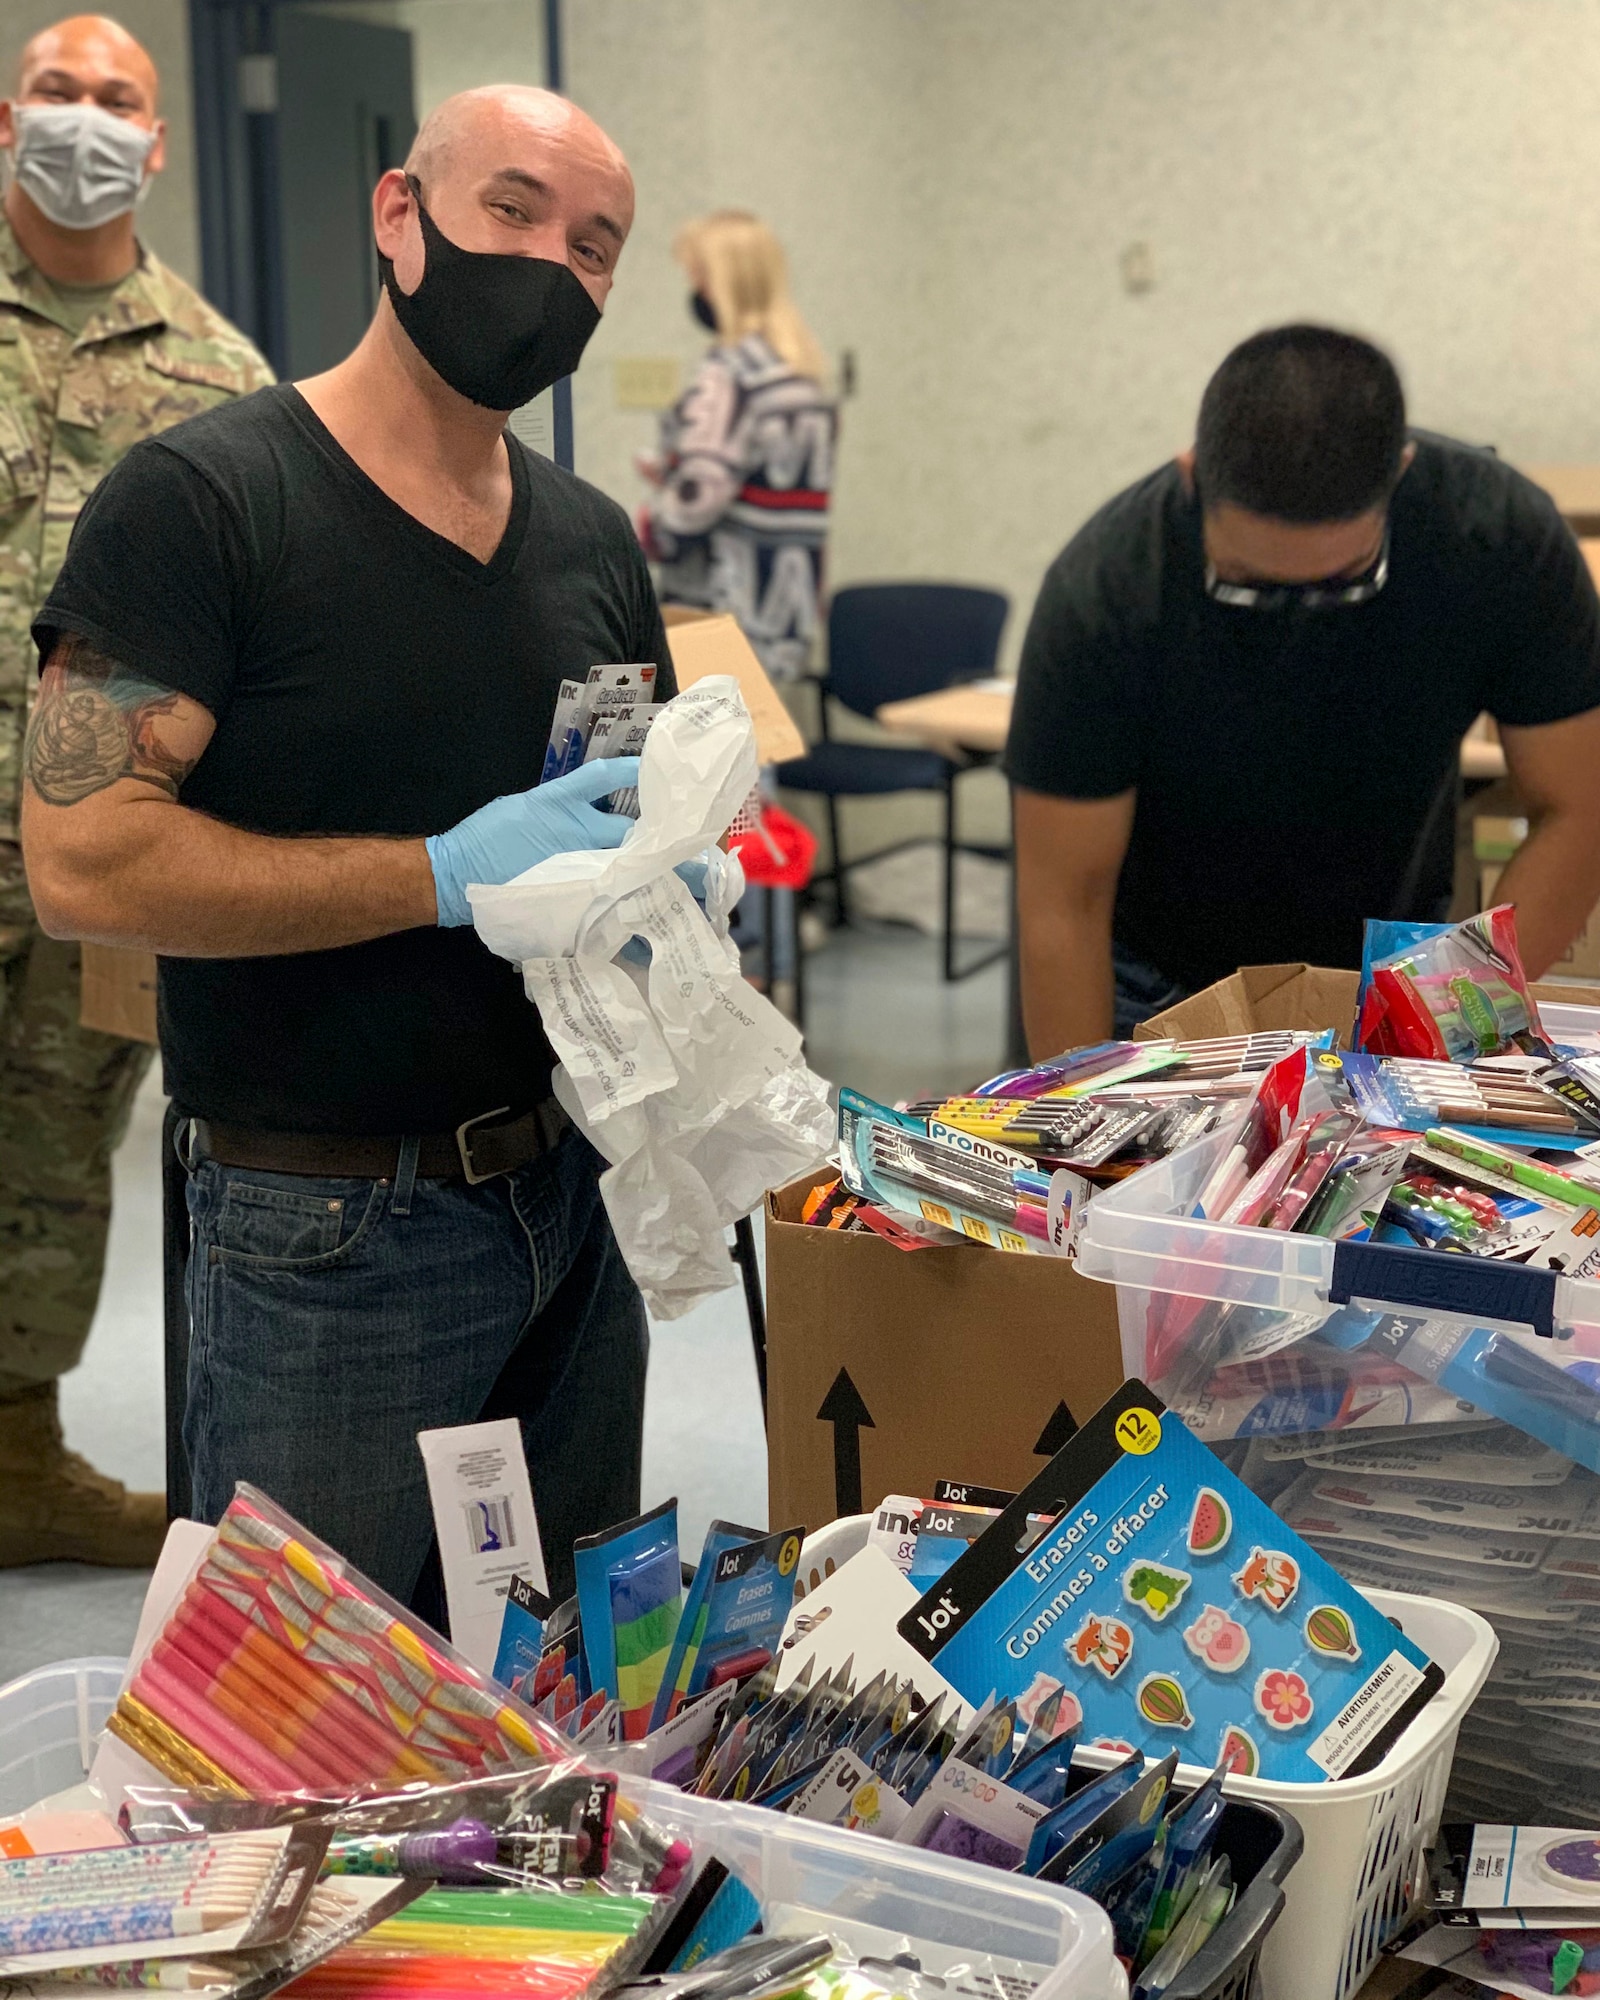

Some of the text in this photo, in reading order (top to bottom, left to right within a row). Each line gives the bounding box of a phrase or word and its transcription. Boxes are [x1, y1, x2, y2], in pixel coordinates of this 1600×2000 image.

[1382, 1318, 1409, 1346] Jot
[1426, 1340, 1454, 1373] Stylos
[1118, 1413, 1148, 1441] 12
[1136, 1429, 1152, 1447] count
[943, 1483, 968, 1502] Jot
[926, 1512, 955, 1533] Jot
[784, 1540, 794, 1563] 6
[1024, 1508, 1099, 1584] Erasers
[721, 1555, 741, 1576] Jot
[1006, 1483, 1171, 1660] Gommes à effacer
[514, 1580, 533, 1606] Jot
[737, 1581, 774, 1605] Erasers
[725, 1607, 773, 1633] Gommes
[917, 1594, 960, 1641] Jot
[515, 1639, 542, 1665] Gomm
[1338, 1663, 1396, 1729] AVERTISSEMENT:
[662, 1709, 701, 1735] Gommes
[1325, 1743, 1345, 1765] RISQUE
[812, 1754, 845, 1795] Erasers
[836, 1761, 861, 1794] 5
[588, 1784, 605, 1817] Jot
